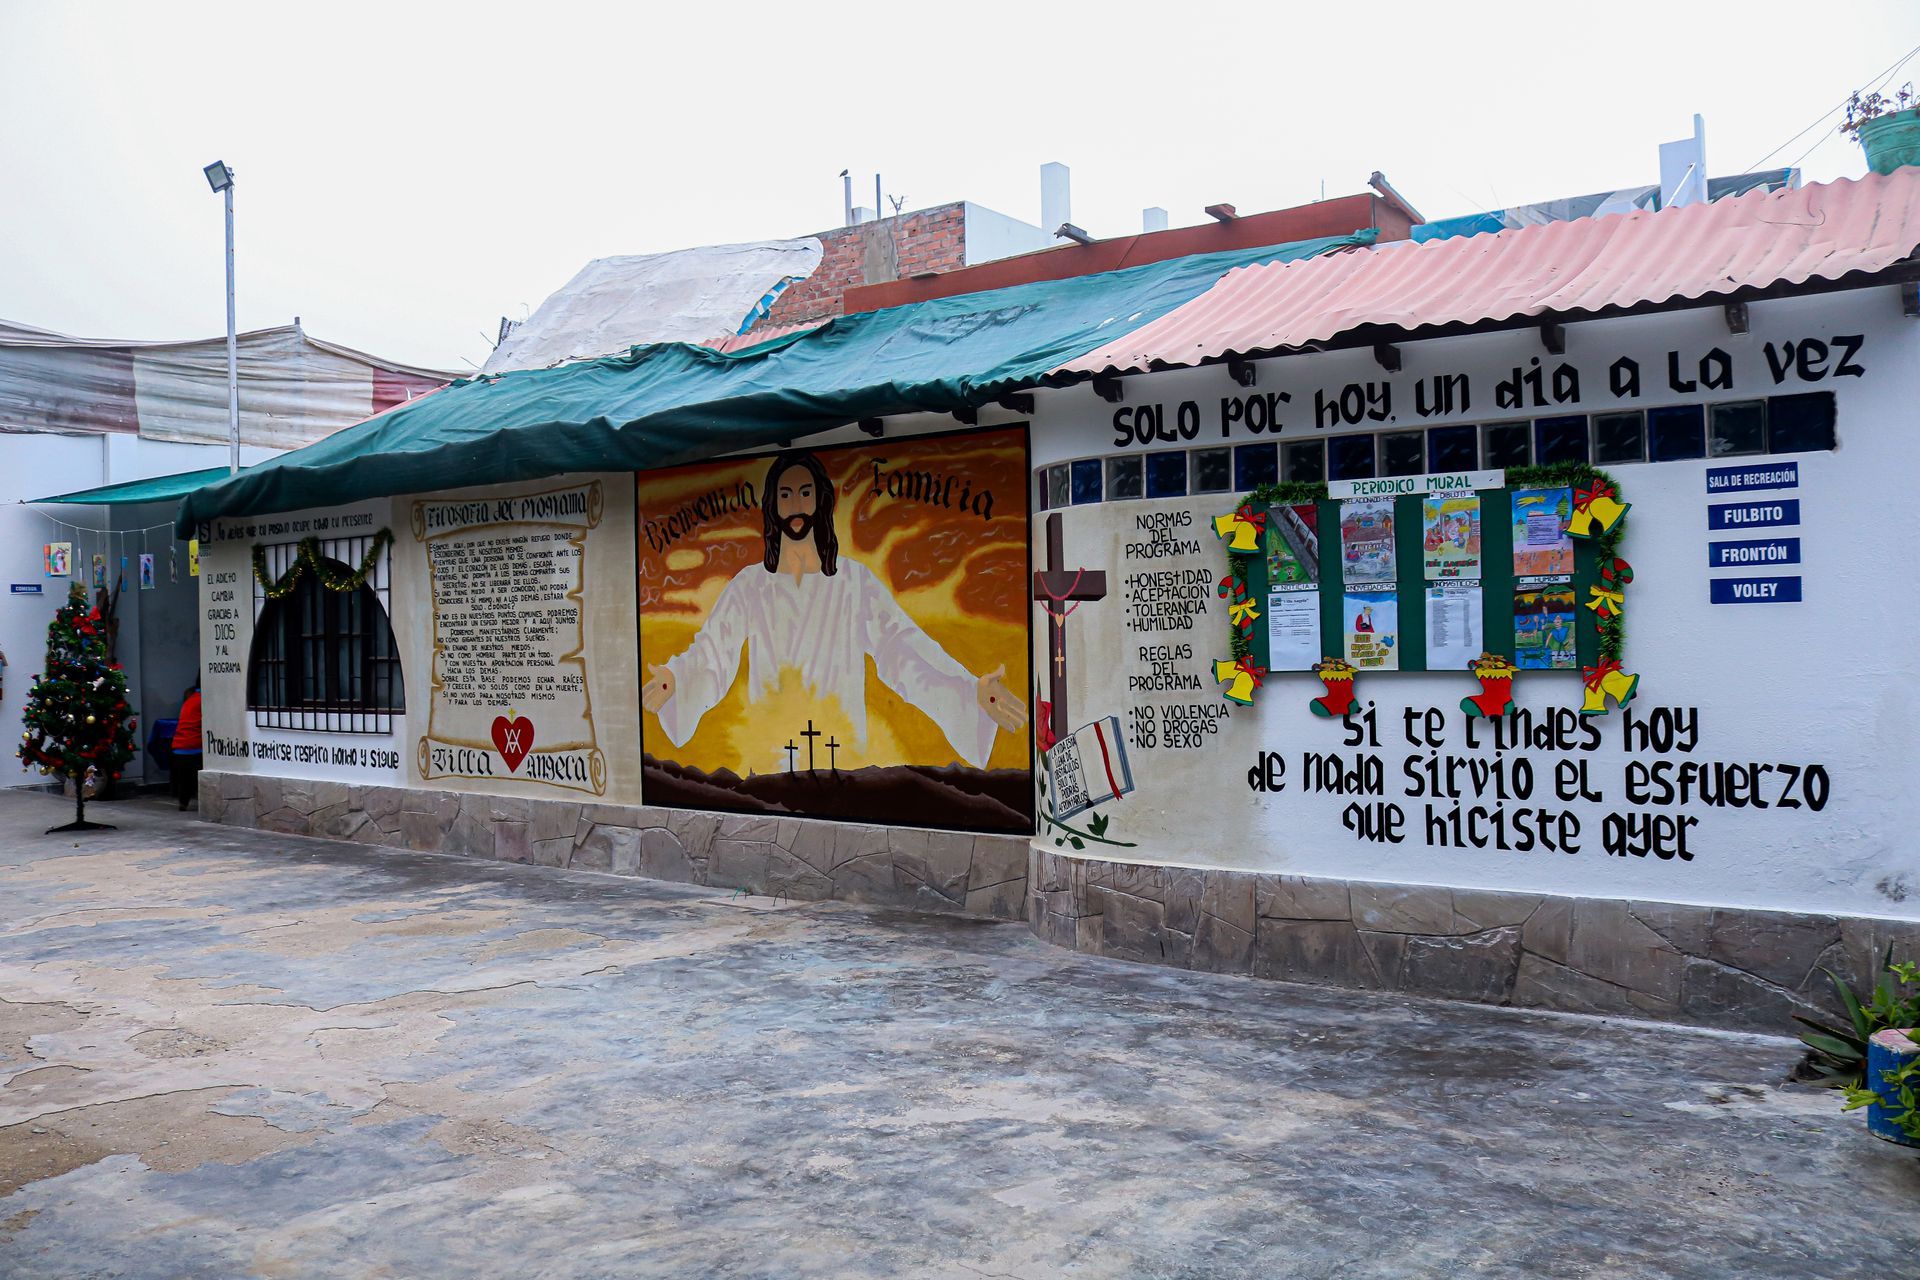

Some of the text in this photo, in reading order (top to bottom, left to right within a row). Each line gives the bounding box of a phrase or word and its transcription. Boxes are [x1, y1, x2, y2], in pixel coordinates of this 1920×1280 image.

[1609, 355, 1640, 399] a
[1763, 334, 1865, 385] vez
[1351, 475, 1471, 495] PERIODICO MURAL
[1709, 468, 1796, 488] SALA DE RECREACIÓN
[870, 456, 996, 521] Familia
[1136, 511, 1192, 530] NORMAS
[1724, 506, 1783, 524] FULBITO
[1149, 528, 1177, 544] DEL
[1126, 540, 1201, 559] PROGRAMA
[1721, 543, 1787, 562] FRONTÓN
[207, 574, 213, 585] EL
[211, 591, 234, 602] CAMBIA
[1732, 583, 1778, 598] VOLEY
[208, 608, 239, 620] GRACIAS A
[215, 624, 236, 640] DIOS
[216, 645, 229, 655] Y AL
[1139, 643, 1193, 662] REGLAS
[208, 662, 241, 673] PROGRAMA
[1152, 661, 1178, 676] DEL
[481, 675, 496, 683] BASE
[1129, 675, 1202, 691] PROGRAMA
[1134, 703, 1230, 720] NO VIOLENCIA
[1135, 719, 1218, 734] NO DROGAS
[1403, 707, 1445, 748] te
[1623, 707, 1698, 753] hoy
[1136, 733, 1203, 749] NO SEXO
[360, 749, 367, 767] y
[1248, 751, 1286, 792] de
[1303, 752, 1384, 795] nada
[1625, 760, 1830, 811] esfuerzo
[1342, 800, 1699, 861] que hiciste ayer
